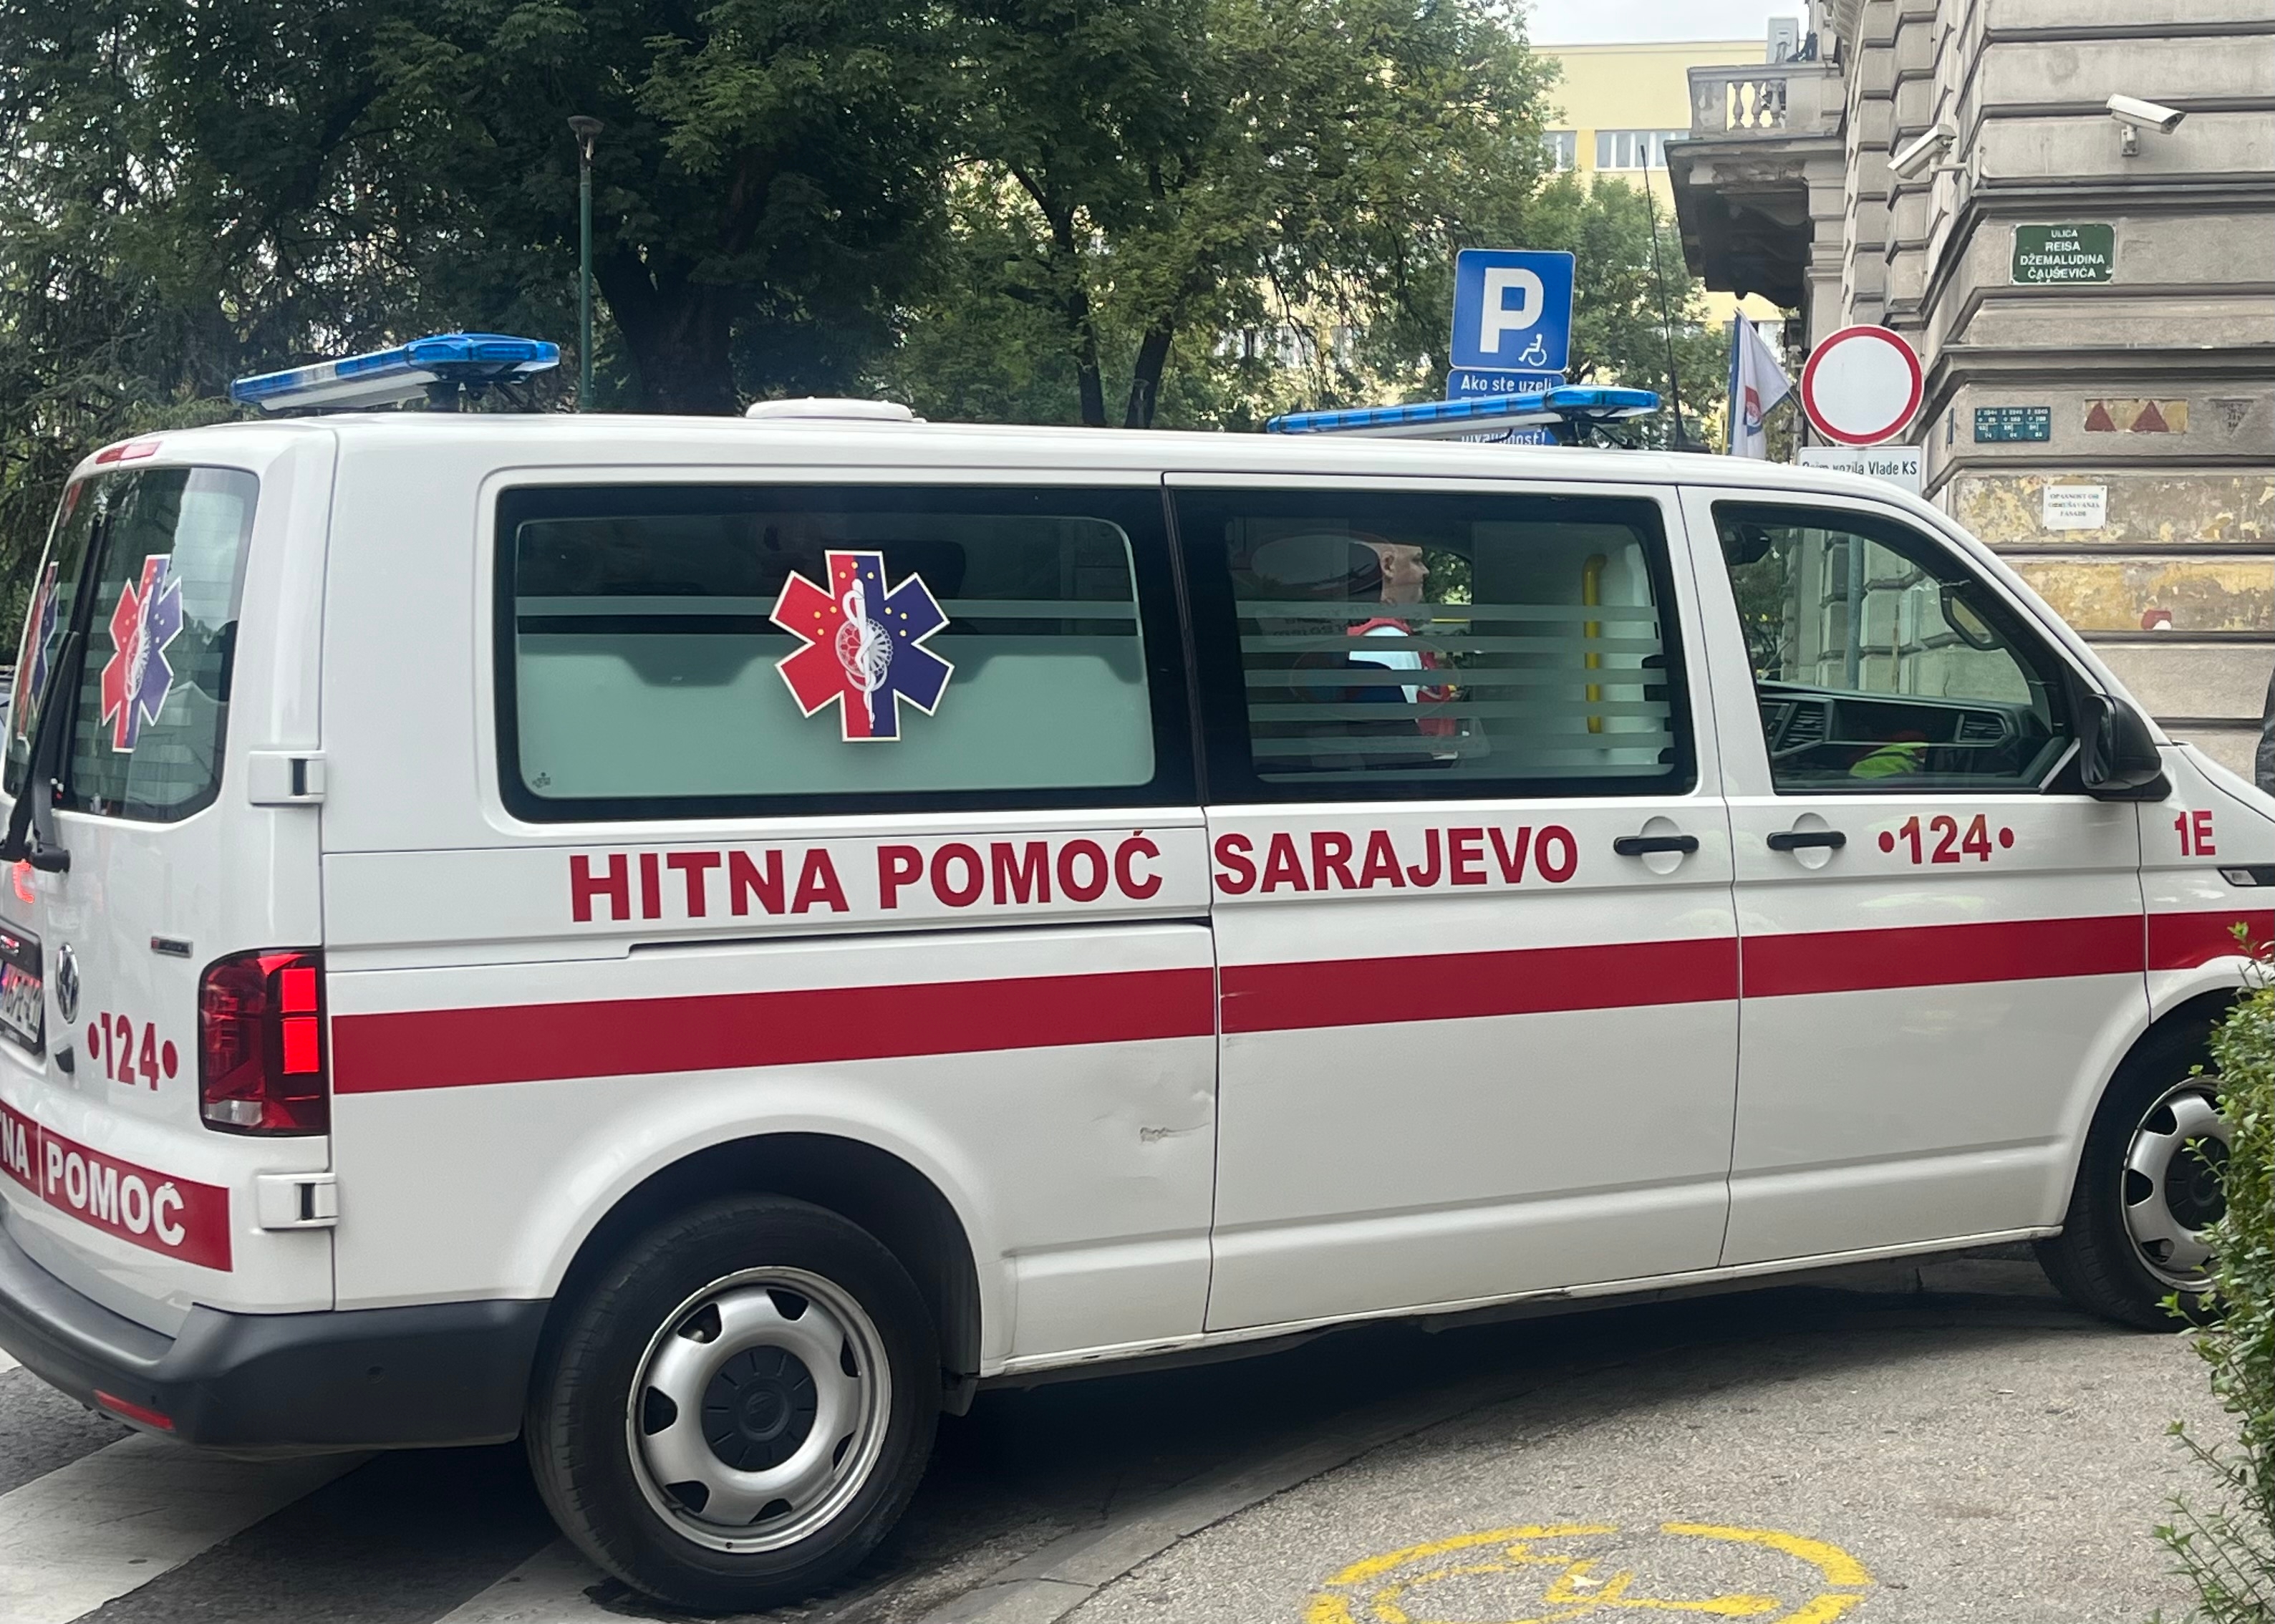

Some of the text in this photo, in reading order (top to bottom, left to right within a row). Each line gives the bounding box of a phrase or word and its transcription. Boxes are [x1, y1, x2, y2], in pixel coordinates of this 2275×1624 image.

[2050, 229, 2078, 238] ULICA
[2044, 241, 2081, 252] REISA
[2019, 252, 2105, 266] DŽEMALUDINA
[2027, 266, 2097, 279] ČAUŠEVIĆA
[1479, 267, 1545, 354] P
[1460, 374, 1552, 393] Ako ste uzeli
[1868, 460, 1898, 475] Vlade
[1902, 460, 1918, 475] KS
[2174, 810, 2216, 856] 1E
[570, 824, 1578, 922] HITNA POMOĆ SARAJEVO
[0, 1109, 187, 1247] NA POMOĆ
